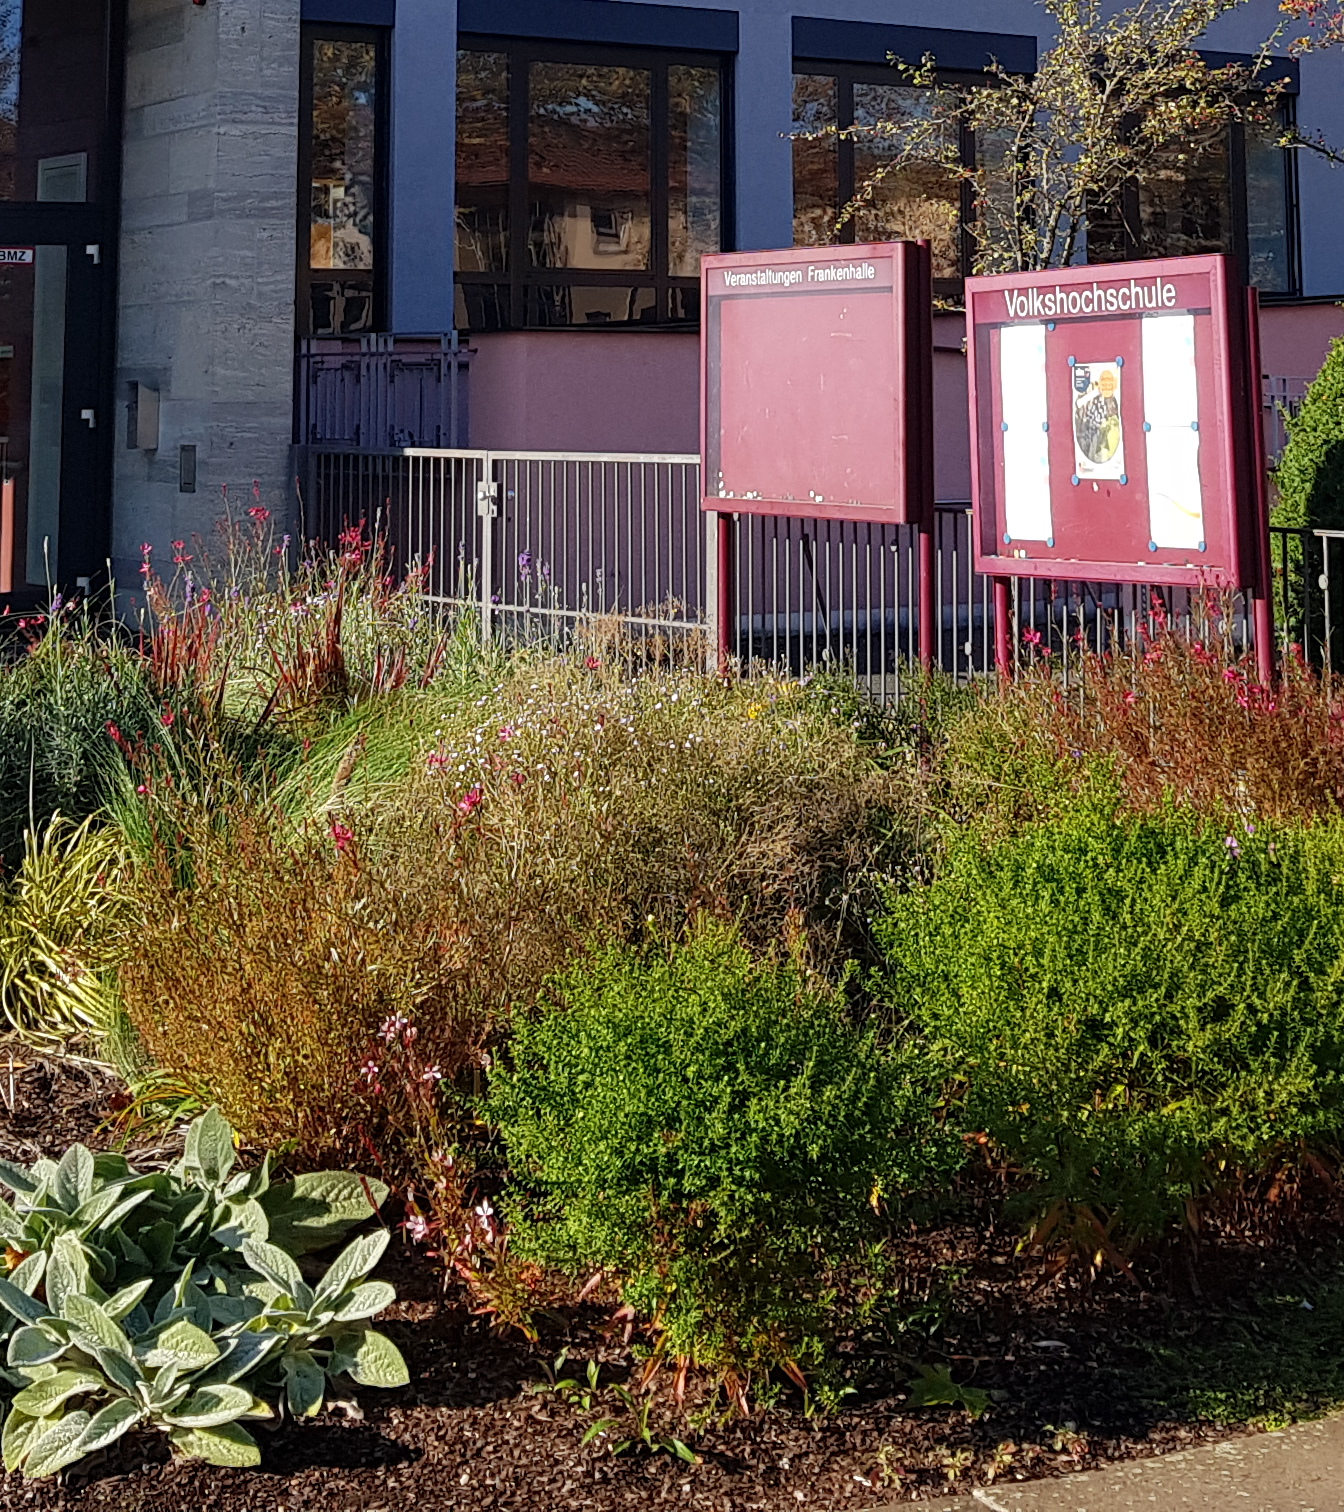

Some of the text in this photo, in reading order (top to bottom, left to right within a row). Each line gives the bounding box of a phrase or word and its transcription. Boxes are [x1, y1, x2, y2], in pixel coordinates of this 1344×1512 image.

[724, 262, 875, 287] Veranstaltungen Frankenhalle
[1004, 277, 1176, 317] Volkshochschule
